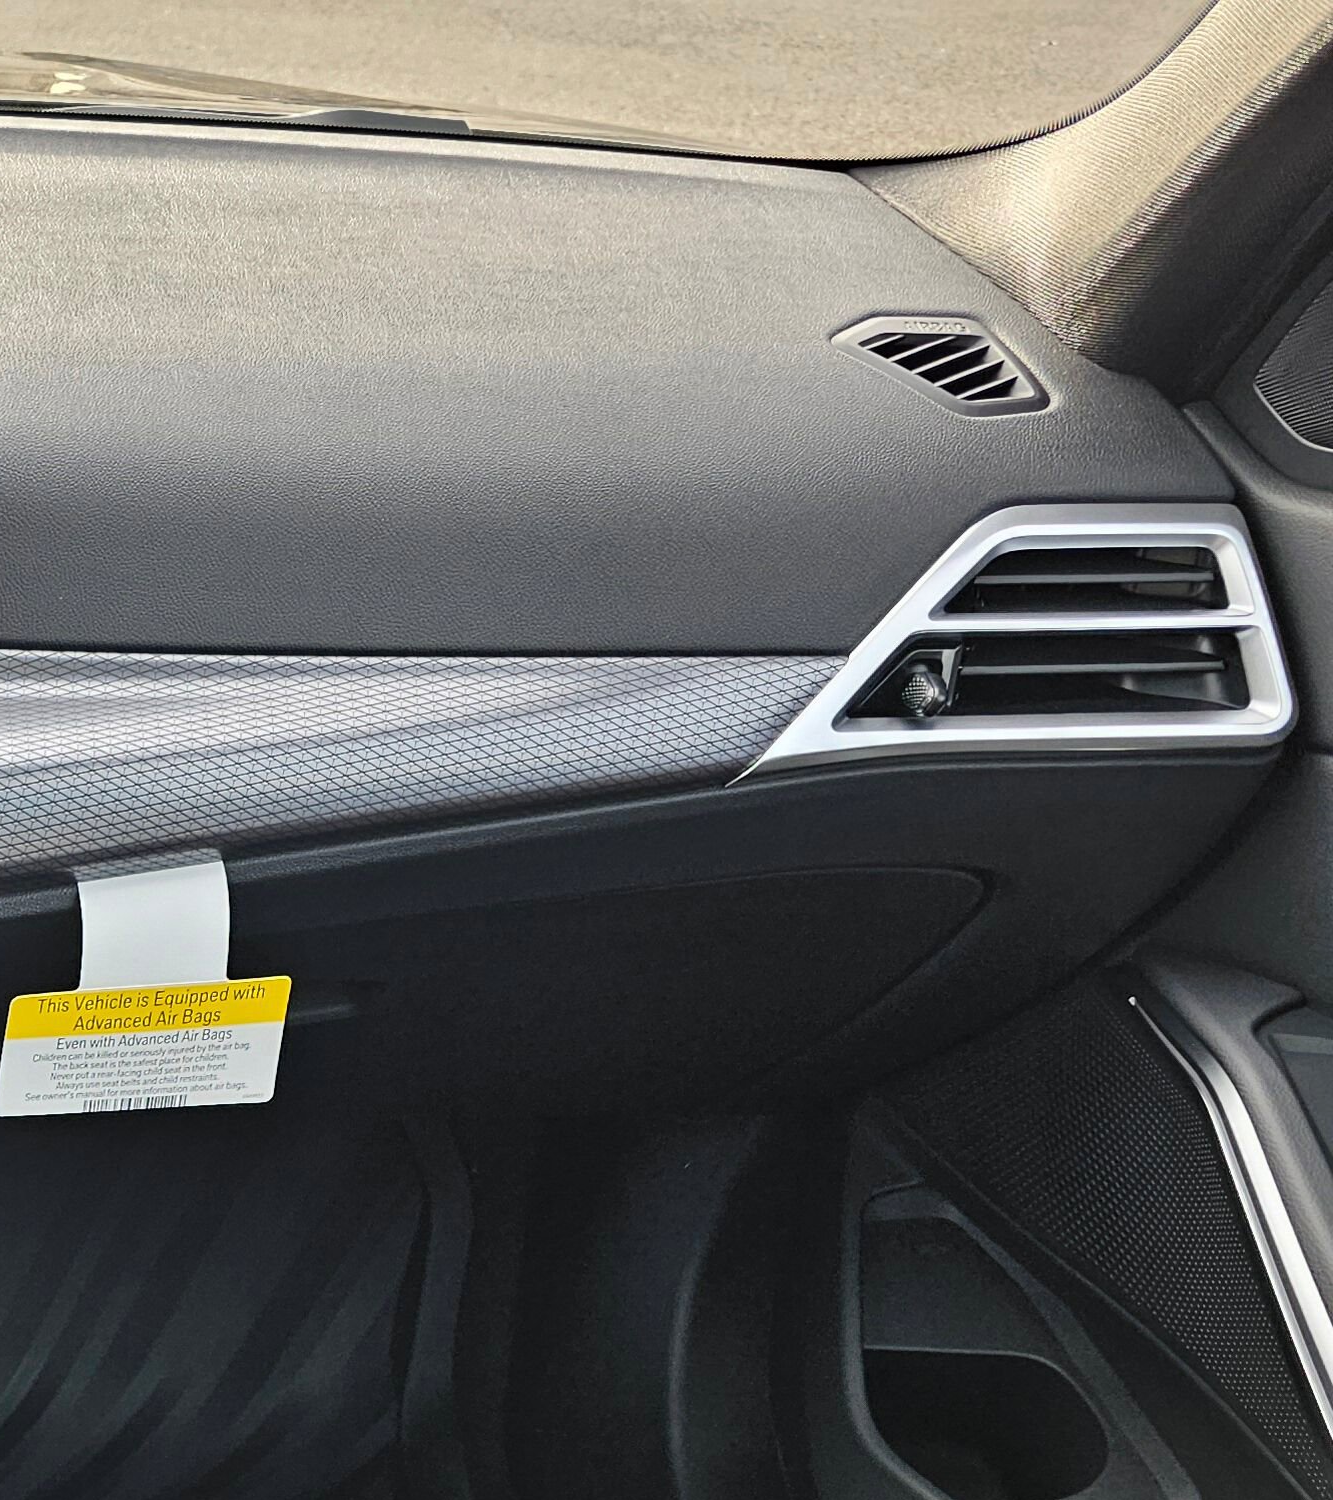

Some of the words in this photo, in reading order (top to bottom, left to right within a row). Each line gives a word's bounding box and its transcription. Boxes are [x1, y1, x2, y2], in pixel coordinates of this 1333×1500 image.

[38, 998, 69, 1014] This
[74, 993, 132, 1011] Vehicle
[136, 993, 149, 1008] is
[154, 986, 230, 1008] Equipped
[233, 984, 265, 1001] with
[73, 1012, 152, 1031] Advanced
[155, 1010, 178, 1026] Air
[182, 1008, 222, 1027] Bags
[56, 1037, 87, 1050] Even
[89, 1036, 116, 1048] with
[118, 1031, 179, 1047] Advanced
[181, 1030, 199, 1043] Air
[201, 1028, 233, 1043] Bags
[32, 1053, 67, 1063] Children
[68, 1053, 84, 1061] can
[84, 1051, 96, 1060] be
[96, 1050, 119, 1059] killed
[130, 1047, 166, 1057] seriously
[167, 1045, 196, 1056] injured
[196, 1045, 207, 1055] by
[208, 1043, 221, 1052] the
[53, 1062, 68, 1071] The
[69, 1061, 88, 1070] back
[90, 1060, 108, 1069] seat
[133, 1058, 158, 1067] safest
[158, 1057, 181, 1066] place
[181, 1055, 194, 1064] for
[194, 1053, 229, 1063] children.
[49, 1072, 74, 1081] Never
[75, 1071, 89, 1080] put
[96, 1068, 142, 1079] rear-facing
[143, 1067, 163, 1076] child
[164, 1066, 182, 1075] seat
[191, 1064, 206, 1072] the
[25, 1092, 41, 1102] See
[75, 1089, 106, 1098] manual
[106, 1088, 118, 1097] for
[119, 1088, 141, 1096] more
[142, 1085, 188, 1095] information
[190, 1083, 213, 1092] about
[55, 1081, 84, 1091] Always
[102, 1080, 119, 1088] seat
[120, 1078, 140, 1087] belts
[141, 1077, 158, 1085] and
[159, 1075, 179, 1085] child
